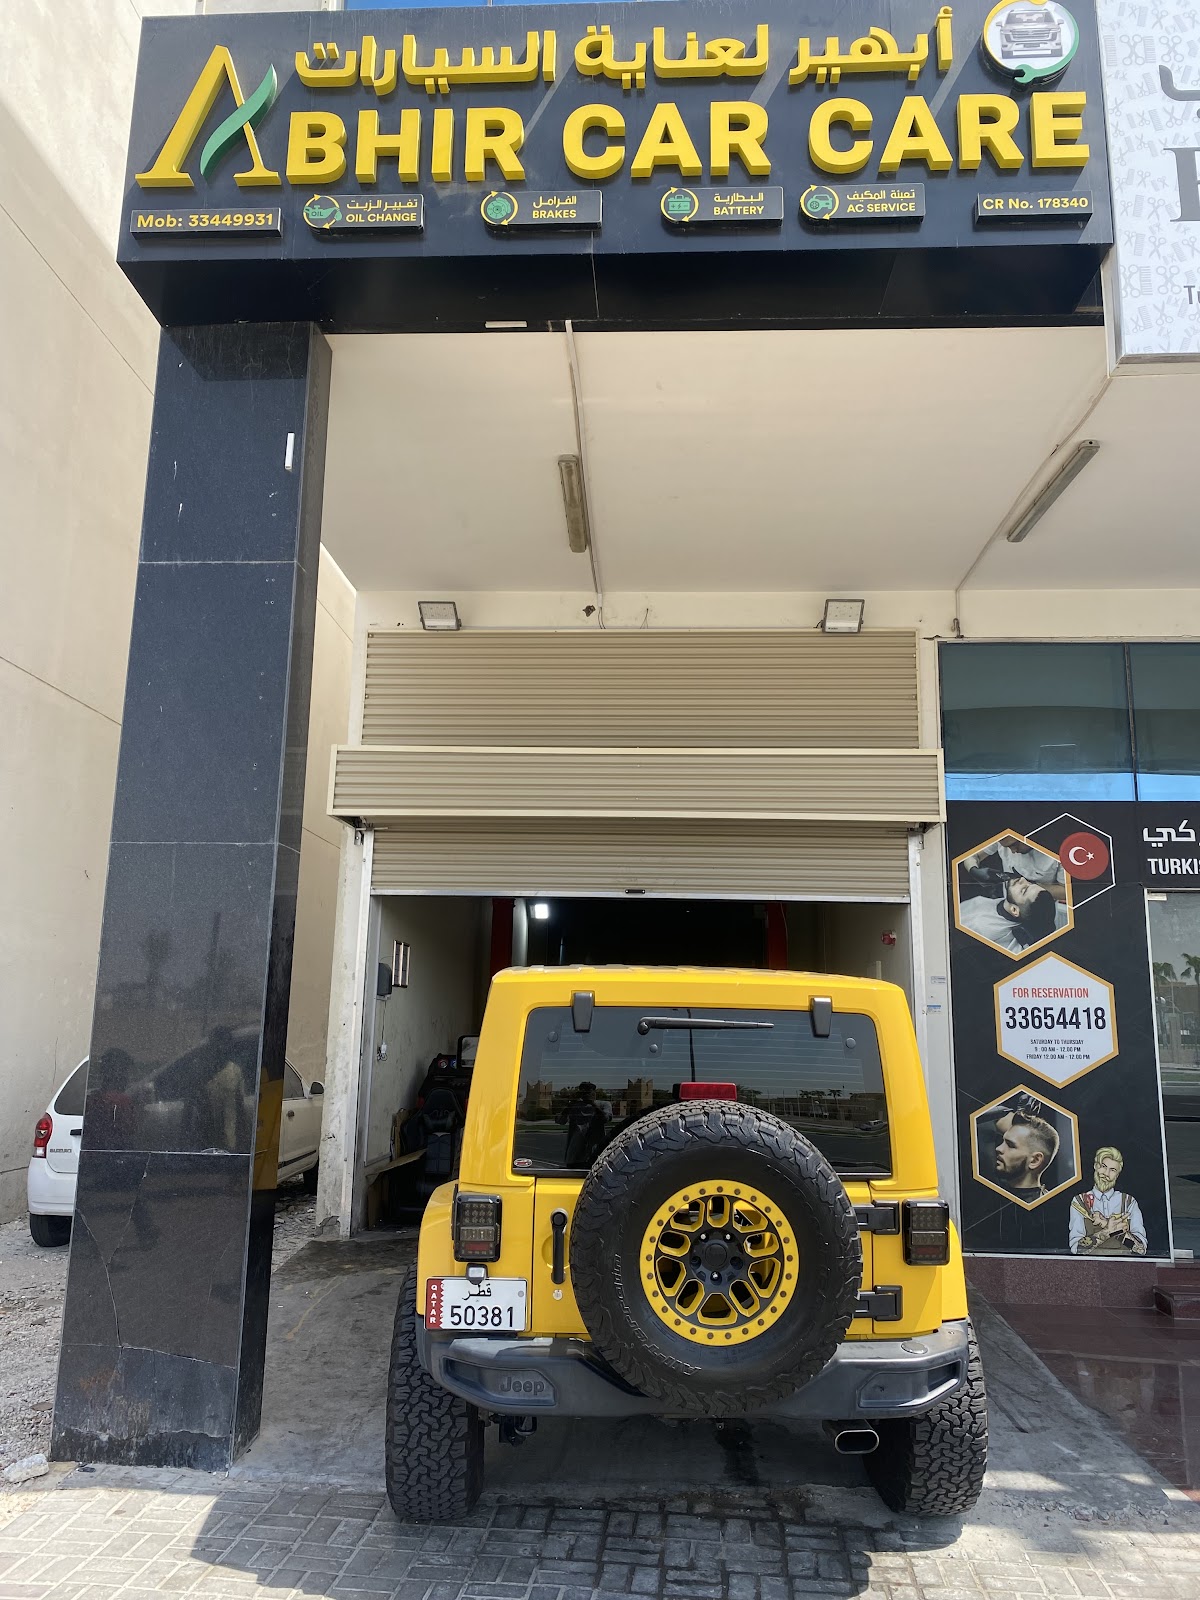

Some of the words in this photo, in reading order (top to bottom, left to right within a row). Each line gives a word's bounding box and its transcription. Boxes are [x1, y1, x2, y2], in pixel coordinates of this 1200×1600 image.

[789, 6, 953, 85] أبهير
[294, 30, 556, 96] السيارات
[574, 24, 769, 90] لعناية
[562, 101, 770, 180] CAR
[808, 91, 1090, 174] CARE
[713, 192, 764, 203] البطارية
[846, 190, 886, 201] المكيف
[890, 189, 916, 200] تعبئة
[346, 199, 381, 210] الزيت
[532, 195, 577, 209] الفرامل
[847, 203, 864, 213] AC
[866, 202, 916, 212] SERVICE
[982, 199, 1004, 210] CR
[1008, 199, 1033, 210] No.
[1038, 197, 1089, 209] 178340
[346, 213, 366, 223] OIL
[368, 212, 417, 222] CHANGE
[532, 209, 577, 219] BRAKES
[713, 205, 764, 216] BATTERY
[137, 214, 183, 229] Mob:
[188, 213, 274, 228] 33449931
[1147, 858, 1200, 875] TURKI
[1012, 988, 1030, 998] FOR
[1031, 988, 1089, 998] RESERVATION
[1005, 1006, 1107, 1030] 33654418
[429, 1284, 438, 1324] QATAR
[450, 1305, 514, 1328] 50381
[500, 1376, 545, 1395] Jeep
